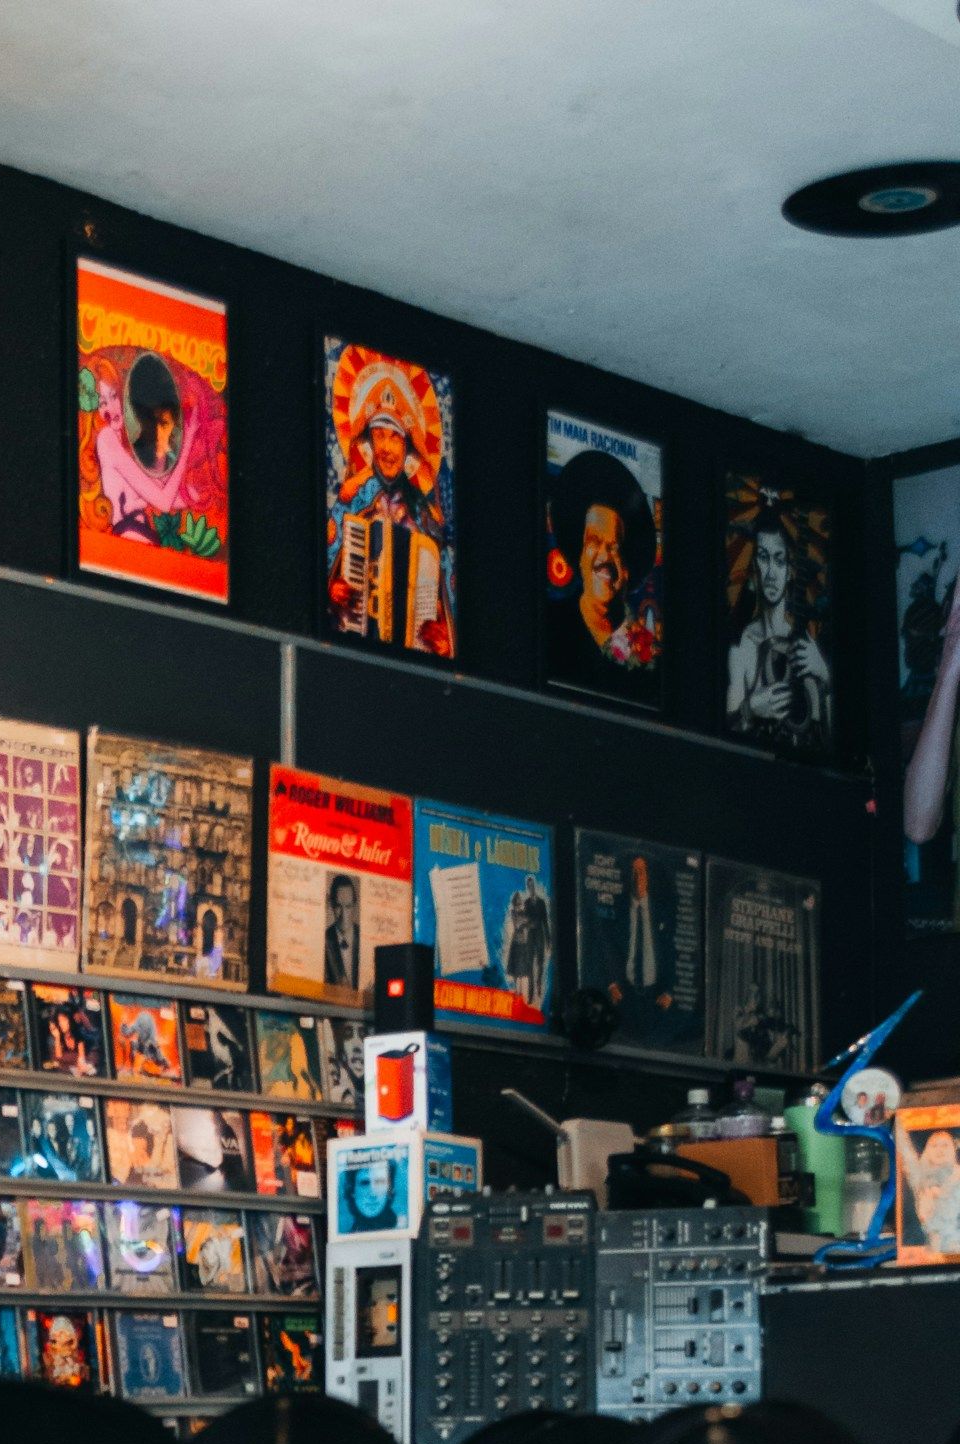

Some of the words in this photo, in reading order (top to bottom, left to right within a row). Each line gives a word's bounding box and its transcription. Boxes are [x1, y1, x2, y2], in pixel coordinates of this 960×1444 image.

[563, 421, 588, 444] MAIA
[590, 430, 637, 461] RACIONAL
[289, 783, 330, 809] ROGER
[334, 794, 396, 827] WILLIAMS
[291, 821, 341, 859] Romeo
[354, 836, 393, 866] Juliet
